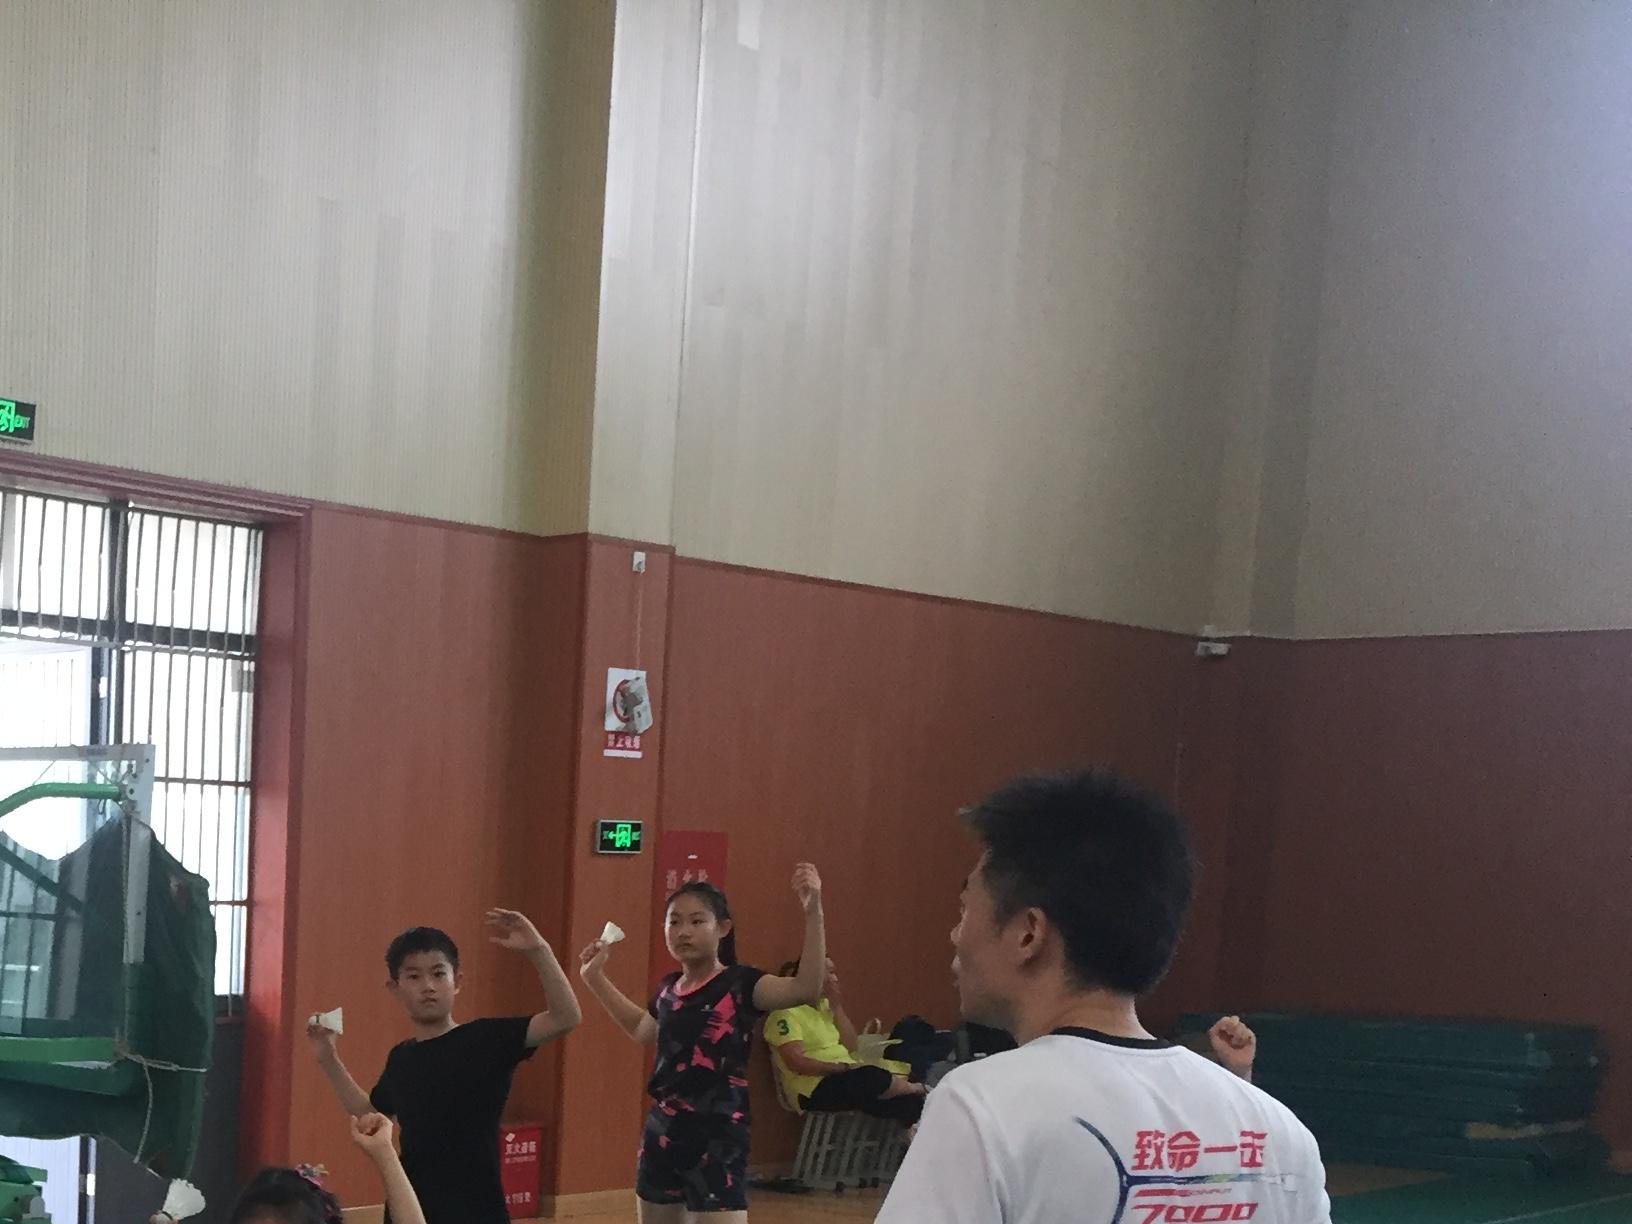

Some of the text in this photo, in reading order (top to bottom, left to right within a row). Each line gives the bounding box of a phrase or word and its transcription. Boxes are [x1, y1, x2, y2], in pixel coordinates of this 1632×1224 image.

[777, 1019, 789, 1036] 3
[1131, 1129, 1267, 1172] 致命一击
